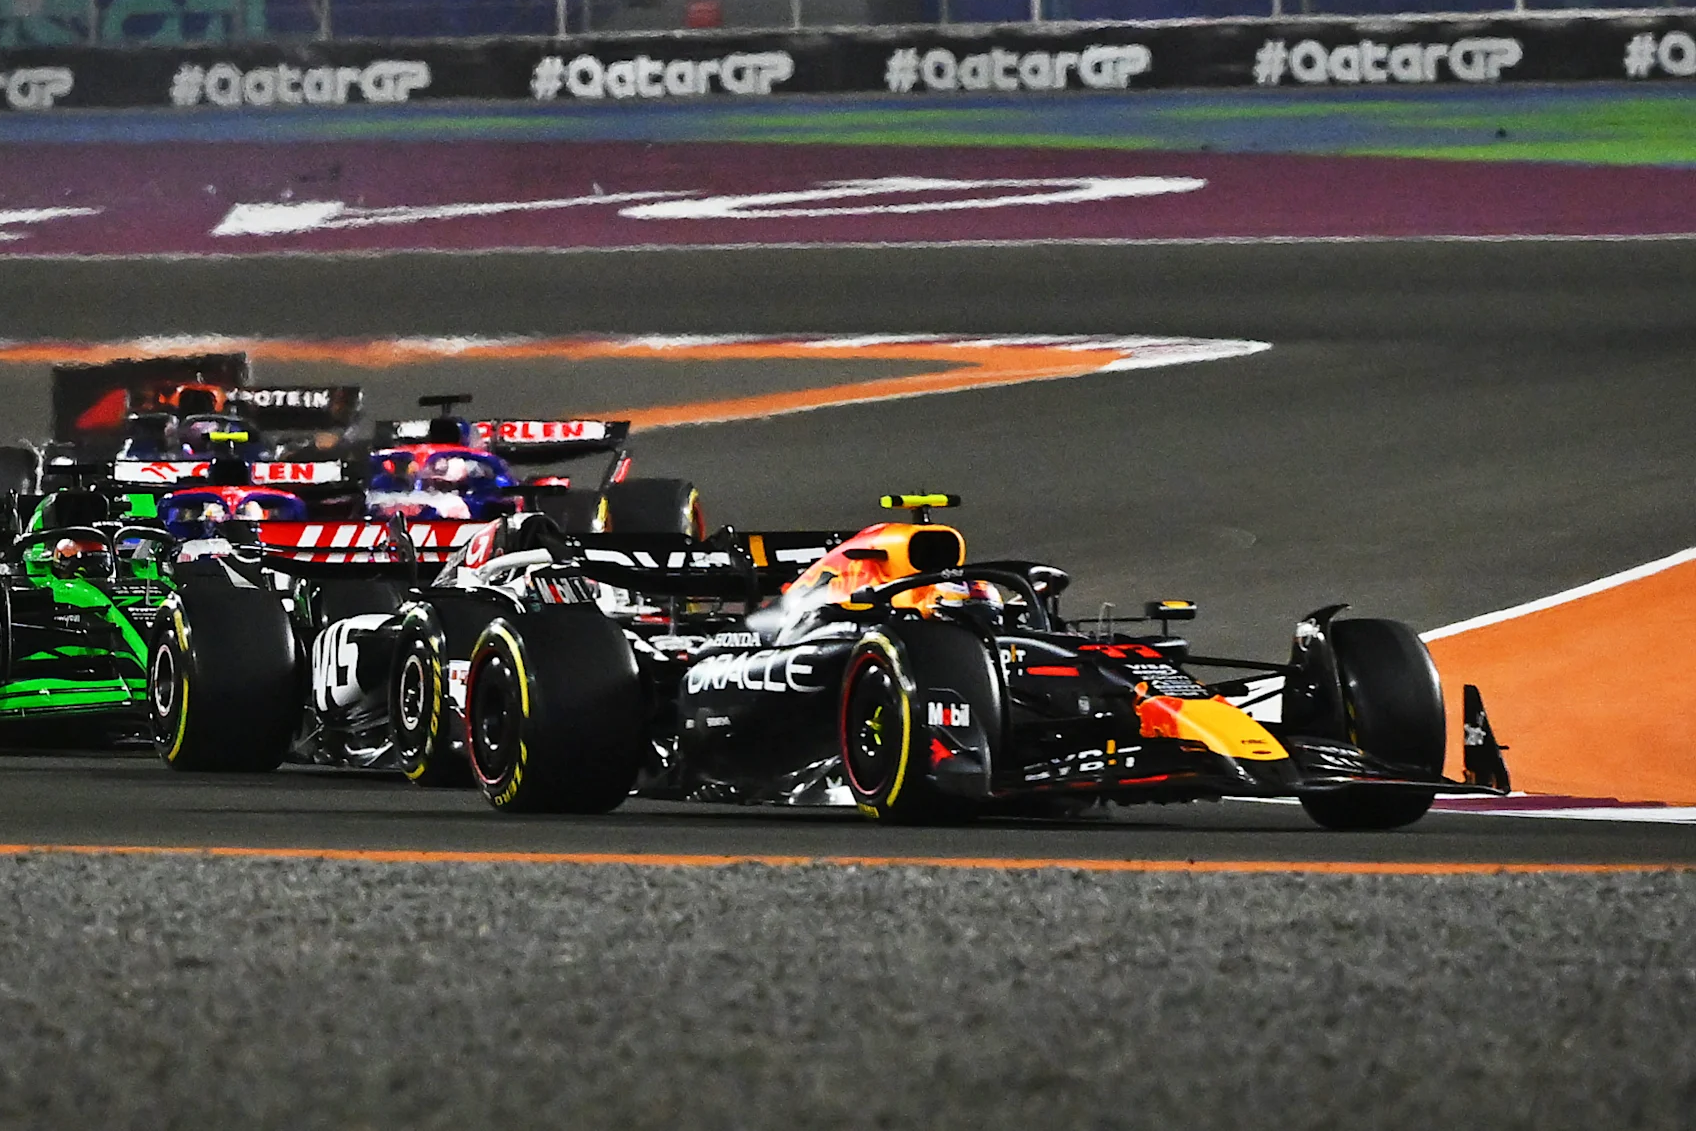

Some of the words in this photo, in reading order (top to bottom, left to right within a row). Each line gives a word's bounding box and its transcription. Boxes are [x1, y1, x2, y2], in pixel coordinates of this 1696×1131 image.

[170, 59, 432, 106] #QatarGP
[529, 49, 795, 99] #QatarGP
[883, 43, 1152, 94] #QatarGP
[1253, 36, 1524, 86] #QatarGP
[715, 632, 762, 647] HONDA
[683, 645, 826, 695] ORACLE
[928, 701, 970, 727] Mobil
